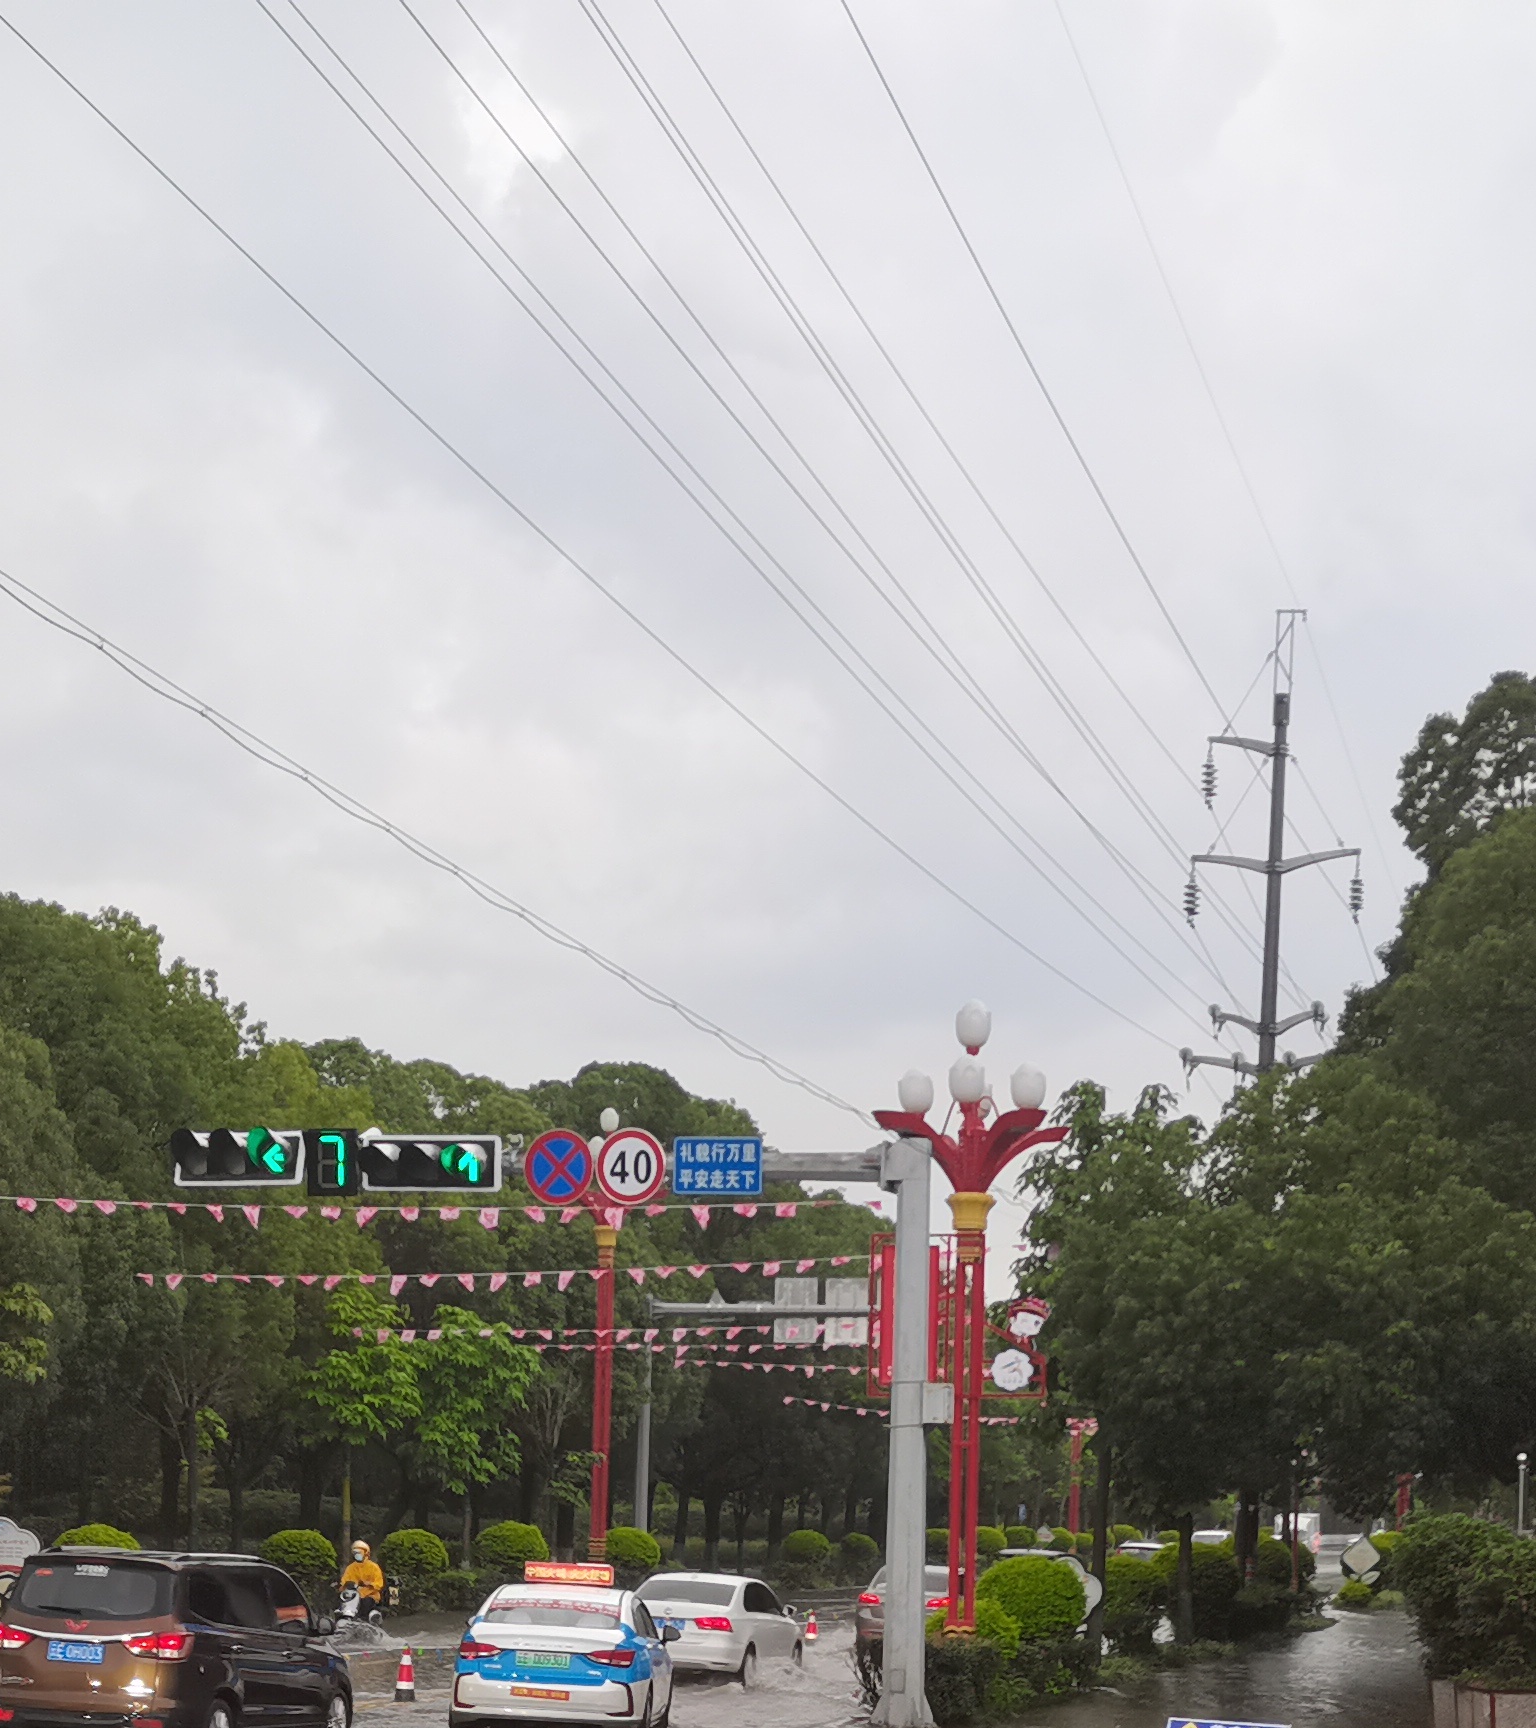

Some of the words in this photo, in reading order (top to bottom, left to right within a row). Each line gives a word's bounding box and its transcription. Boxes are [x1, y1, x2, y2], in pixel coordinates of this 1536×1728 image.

[610, 1150, 652, 1184] 40
[678, 1168, 757, 1189] 平安走天下
